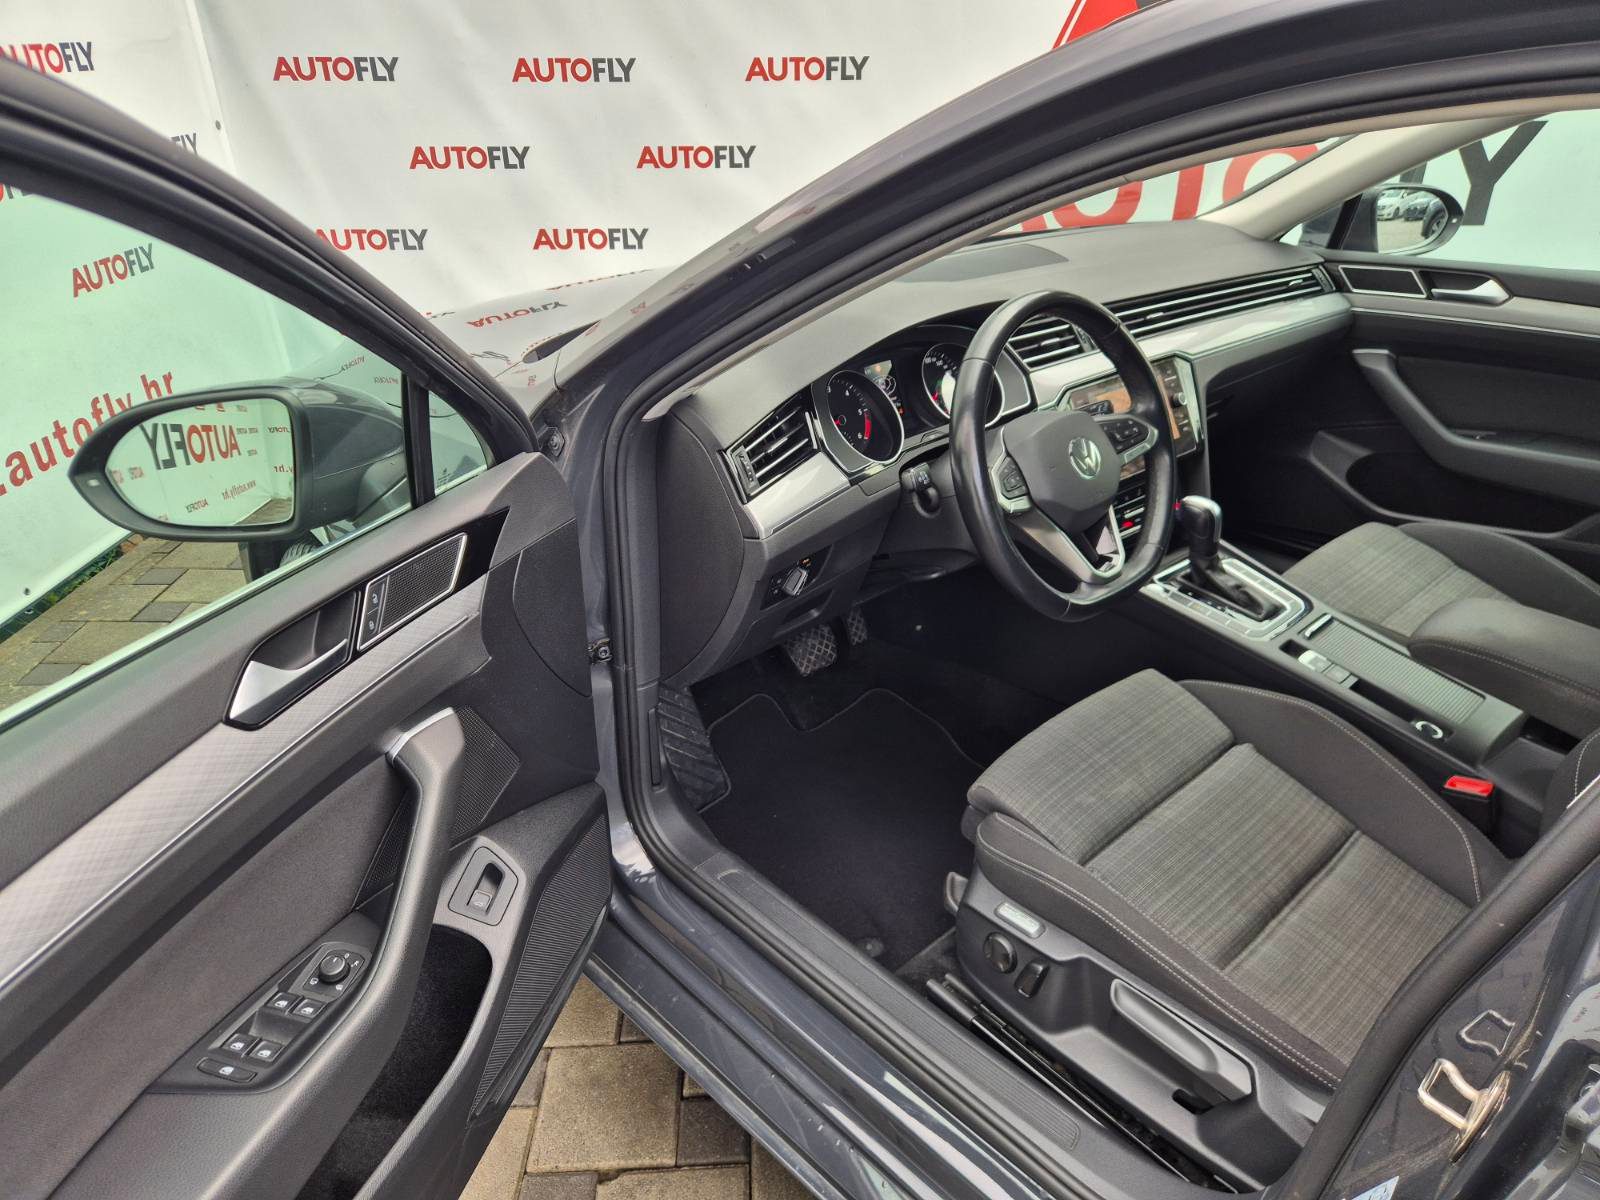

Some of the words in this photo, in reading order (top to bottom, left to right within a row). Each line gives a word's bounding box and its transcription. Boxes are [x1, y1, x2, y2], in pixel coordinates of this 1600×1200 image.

[0, 41, 95, 74] UTOFLY
[273, 56, 398, 81] AUTOFLY
[512, 57, 636, 83] AUTOFLY
[745, 55, 870, 81] AUTOFLY
[409, 146, 530, 169] AUTOFLY
[636, 145, 756, 169] AUTOFLY
[532, 228, 649, 251] AUTOFLY
[72, 243, 155, 297] AUTOFLY
